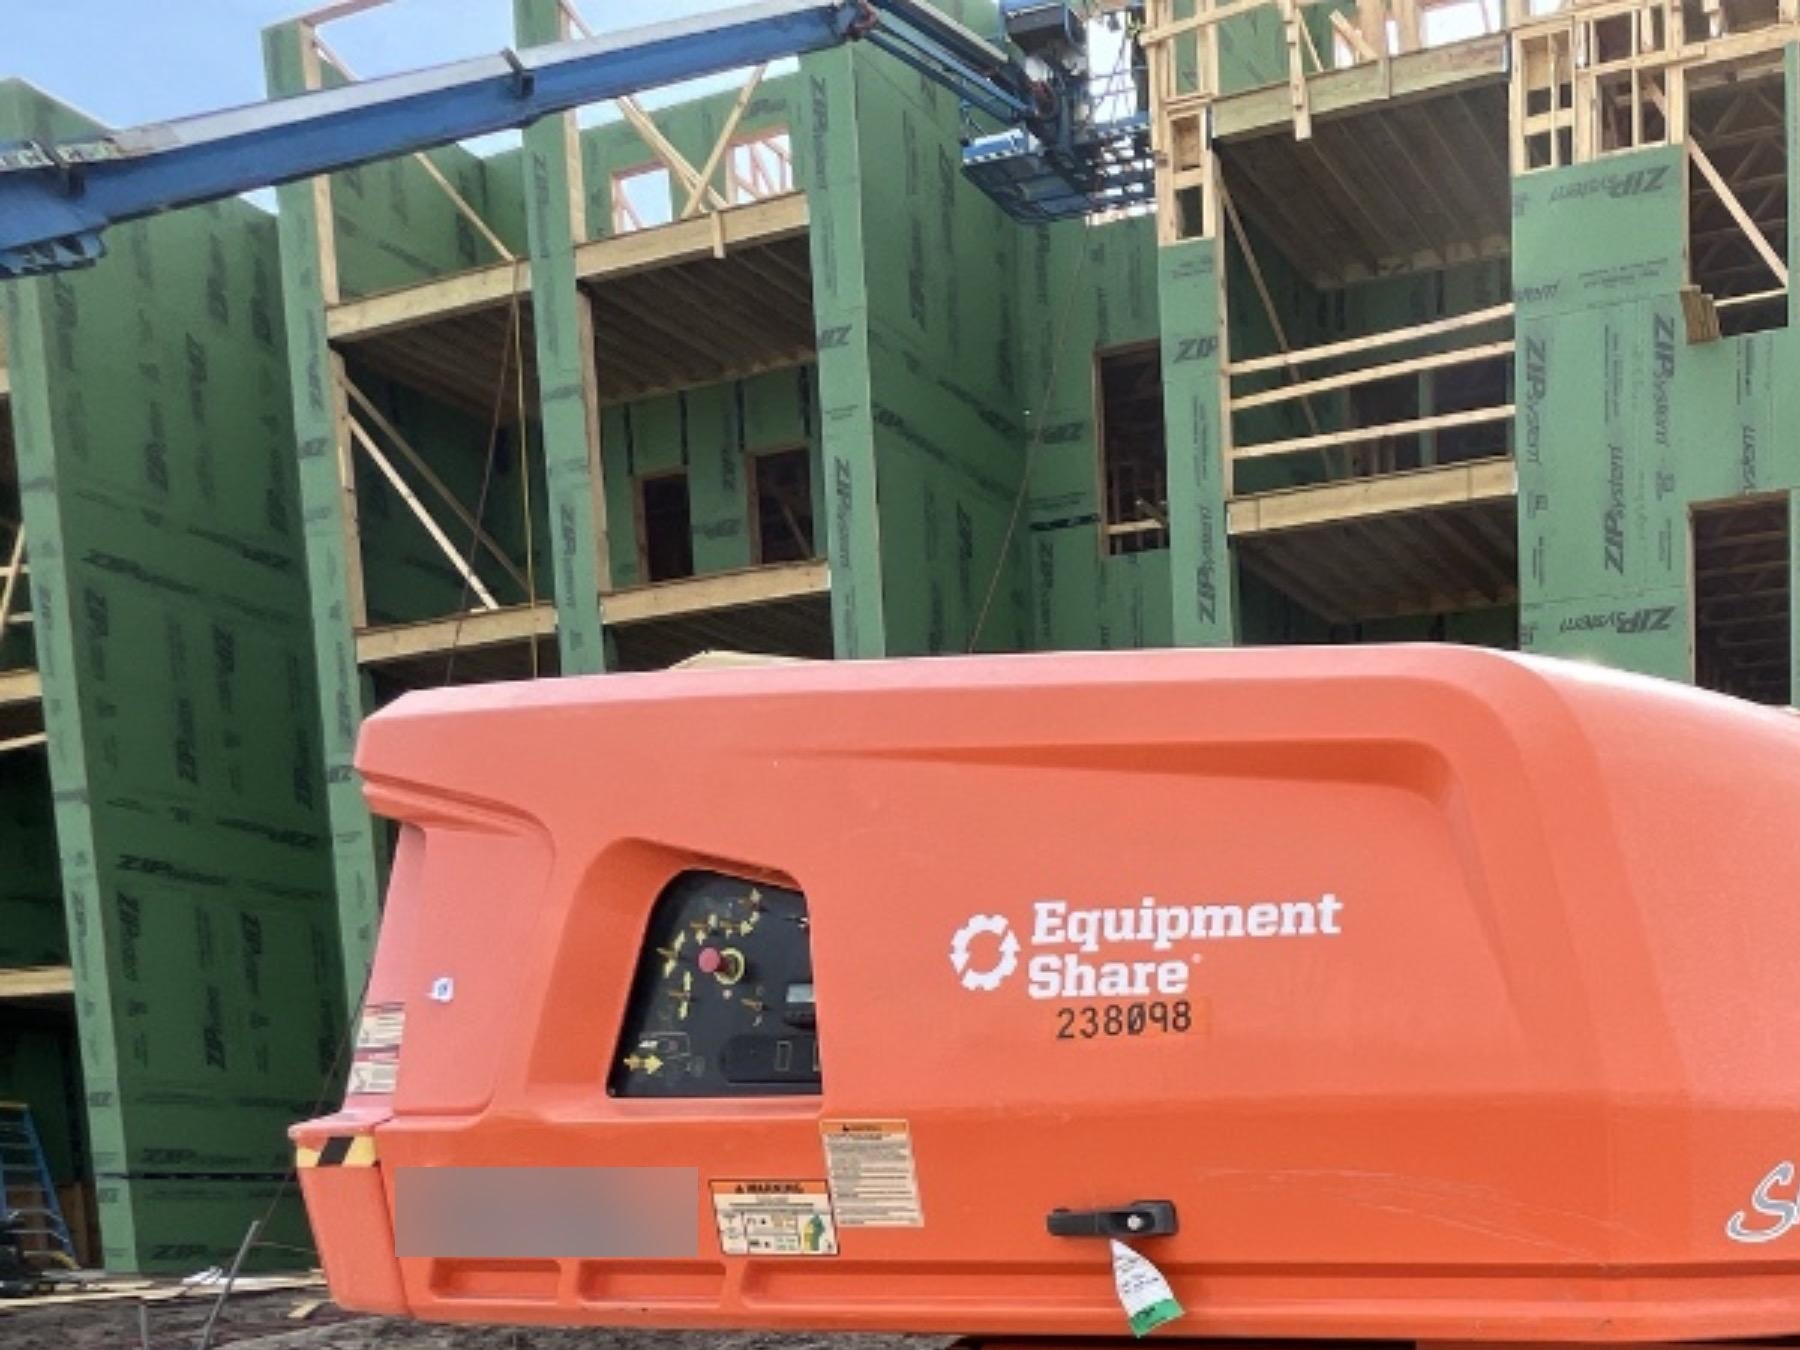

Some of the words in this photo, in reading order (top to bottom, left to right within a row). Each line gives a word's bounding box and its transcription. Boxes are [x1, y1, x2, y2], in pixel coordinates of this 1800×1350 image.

[1031, 893, 1342, 952] Equipment
[1027, 953, 1189, 1000] Share
[1056, 999, 1193, 1040] 238098
